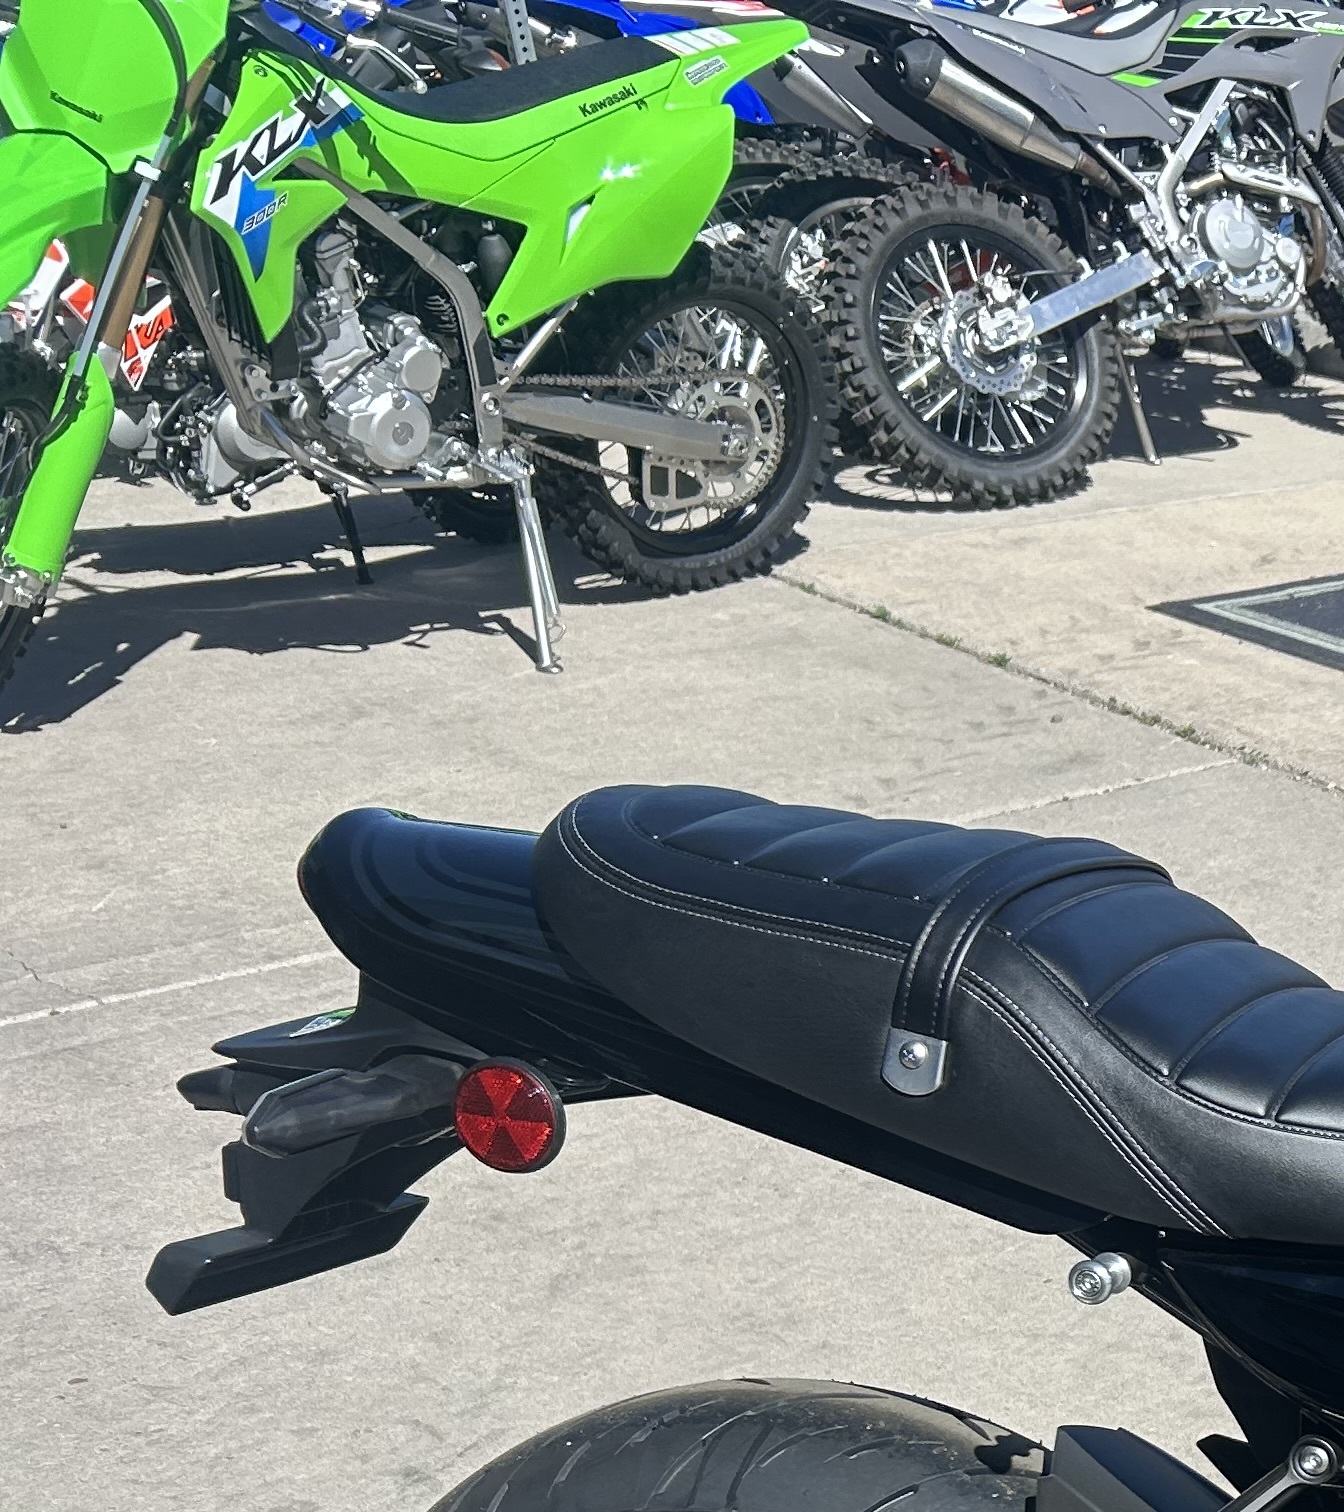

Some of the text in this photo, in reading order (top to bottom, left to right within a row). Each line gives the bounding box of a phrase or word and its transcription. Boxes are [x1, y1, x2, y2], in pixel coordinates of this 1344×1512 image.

[1199, 8, 1328, 32] KLX
[579, 83, 639, 118] Kawasaki
[209, 77, 330, 205] KLX
[243, 192, 288, 233] 300R
